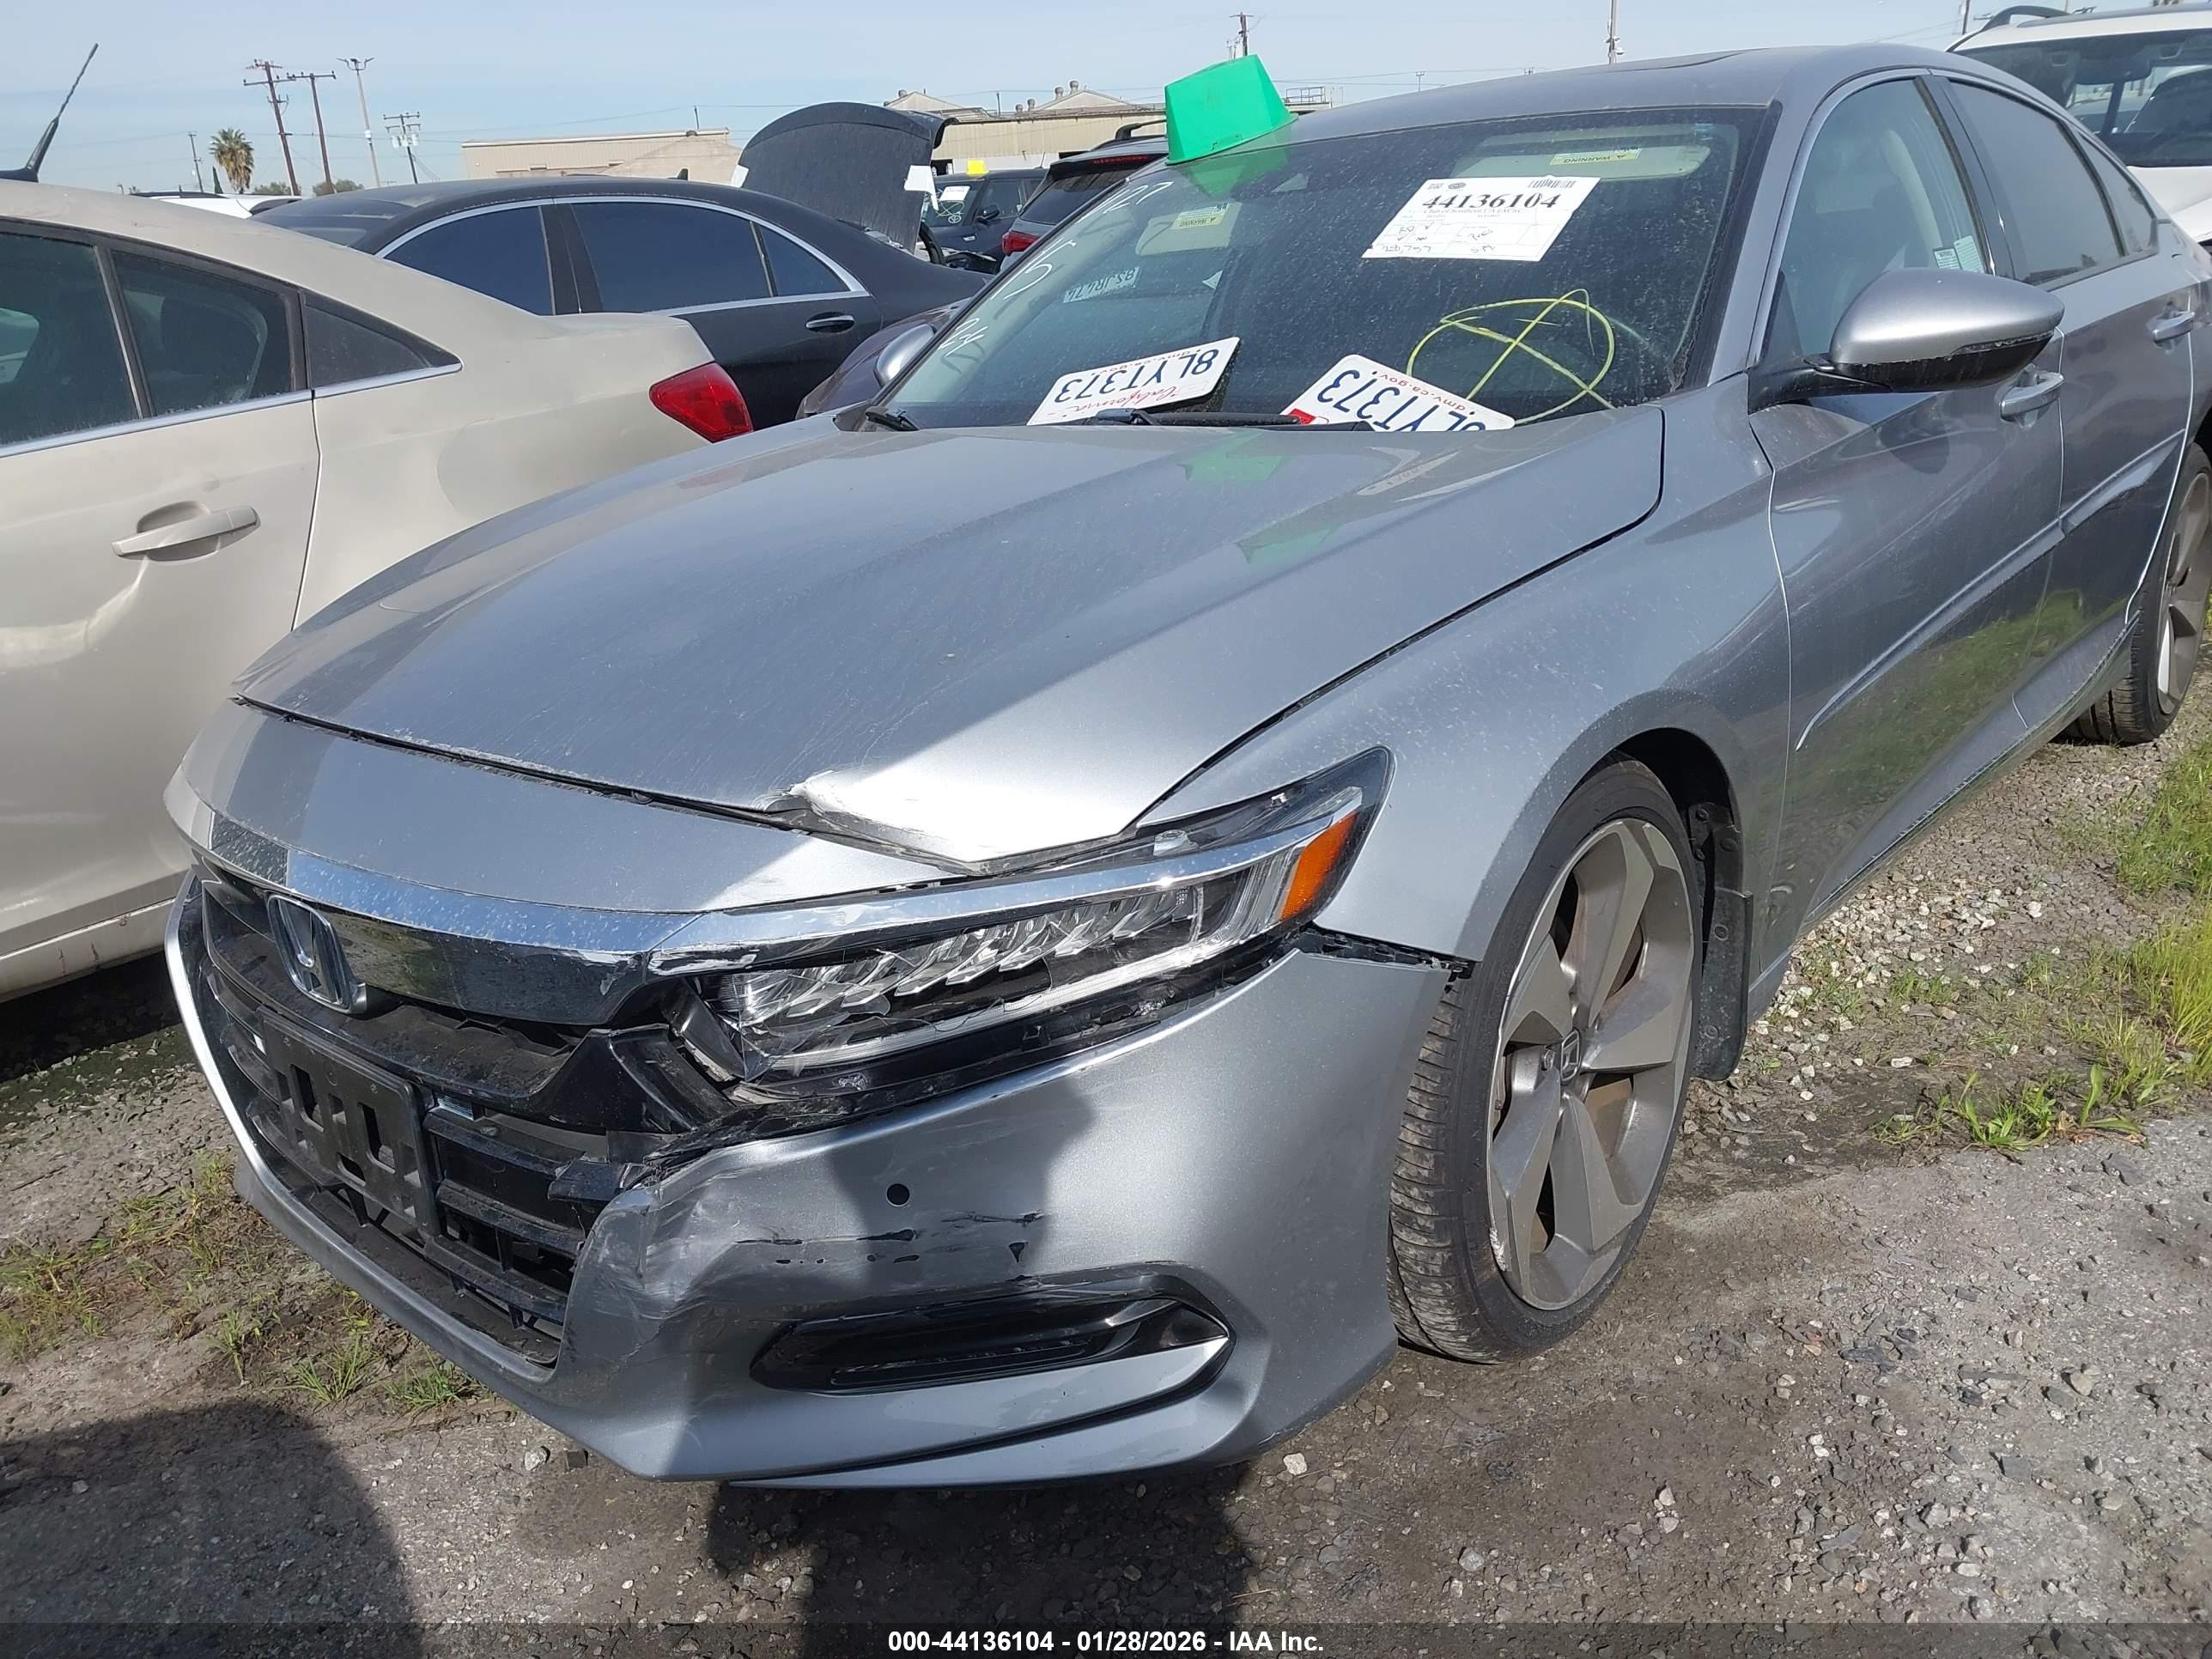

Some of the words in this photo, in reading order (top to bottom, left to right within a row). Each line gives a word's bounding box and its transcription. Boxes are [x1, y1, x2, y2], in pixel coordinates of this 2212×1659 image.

[1422, 191, 1562, 209] 44136104
[1054, 349, 1220, 404] 8LYT373
[1380, 373, 1468, 412] dmv.ca.gov
[1066, 386, 1177, 411] California
